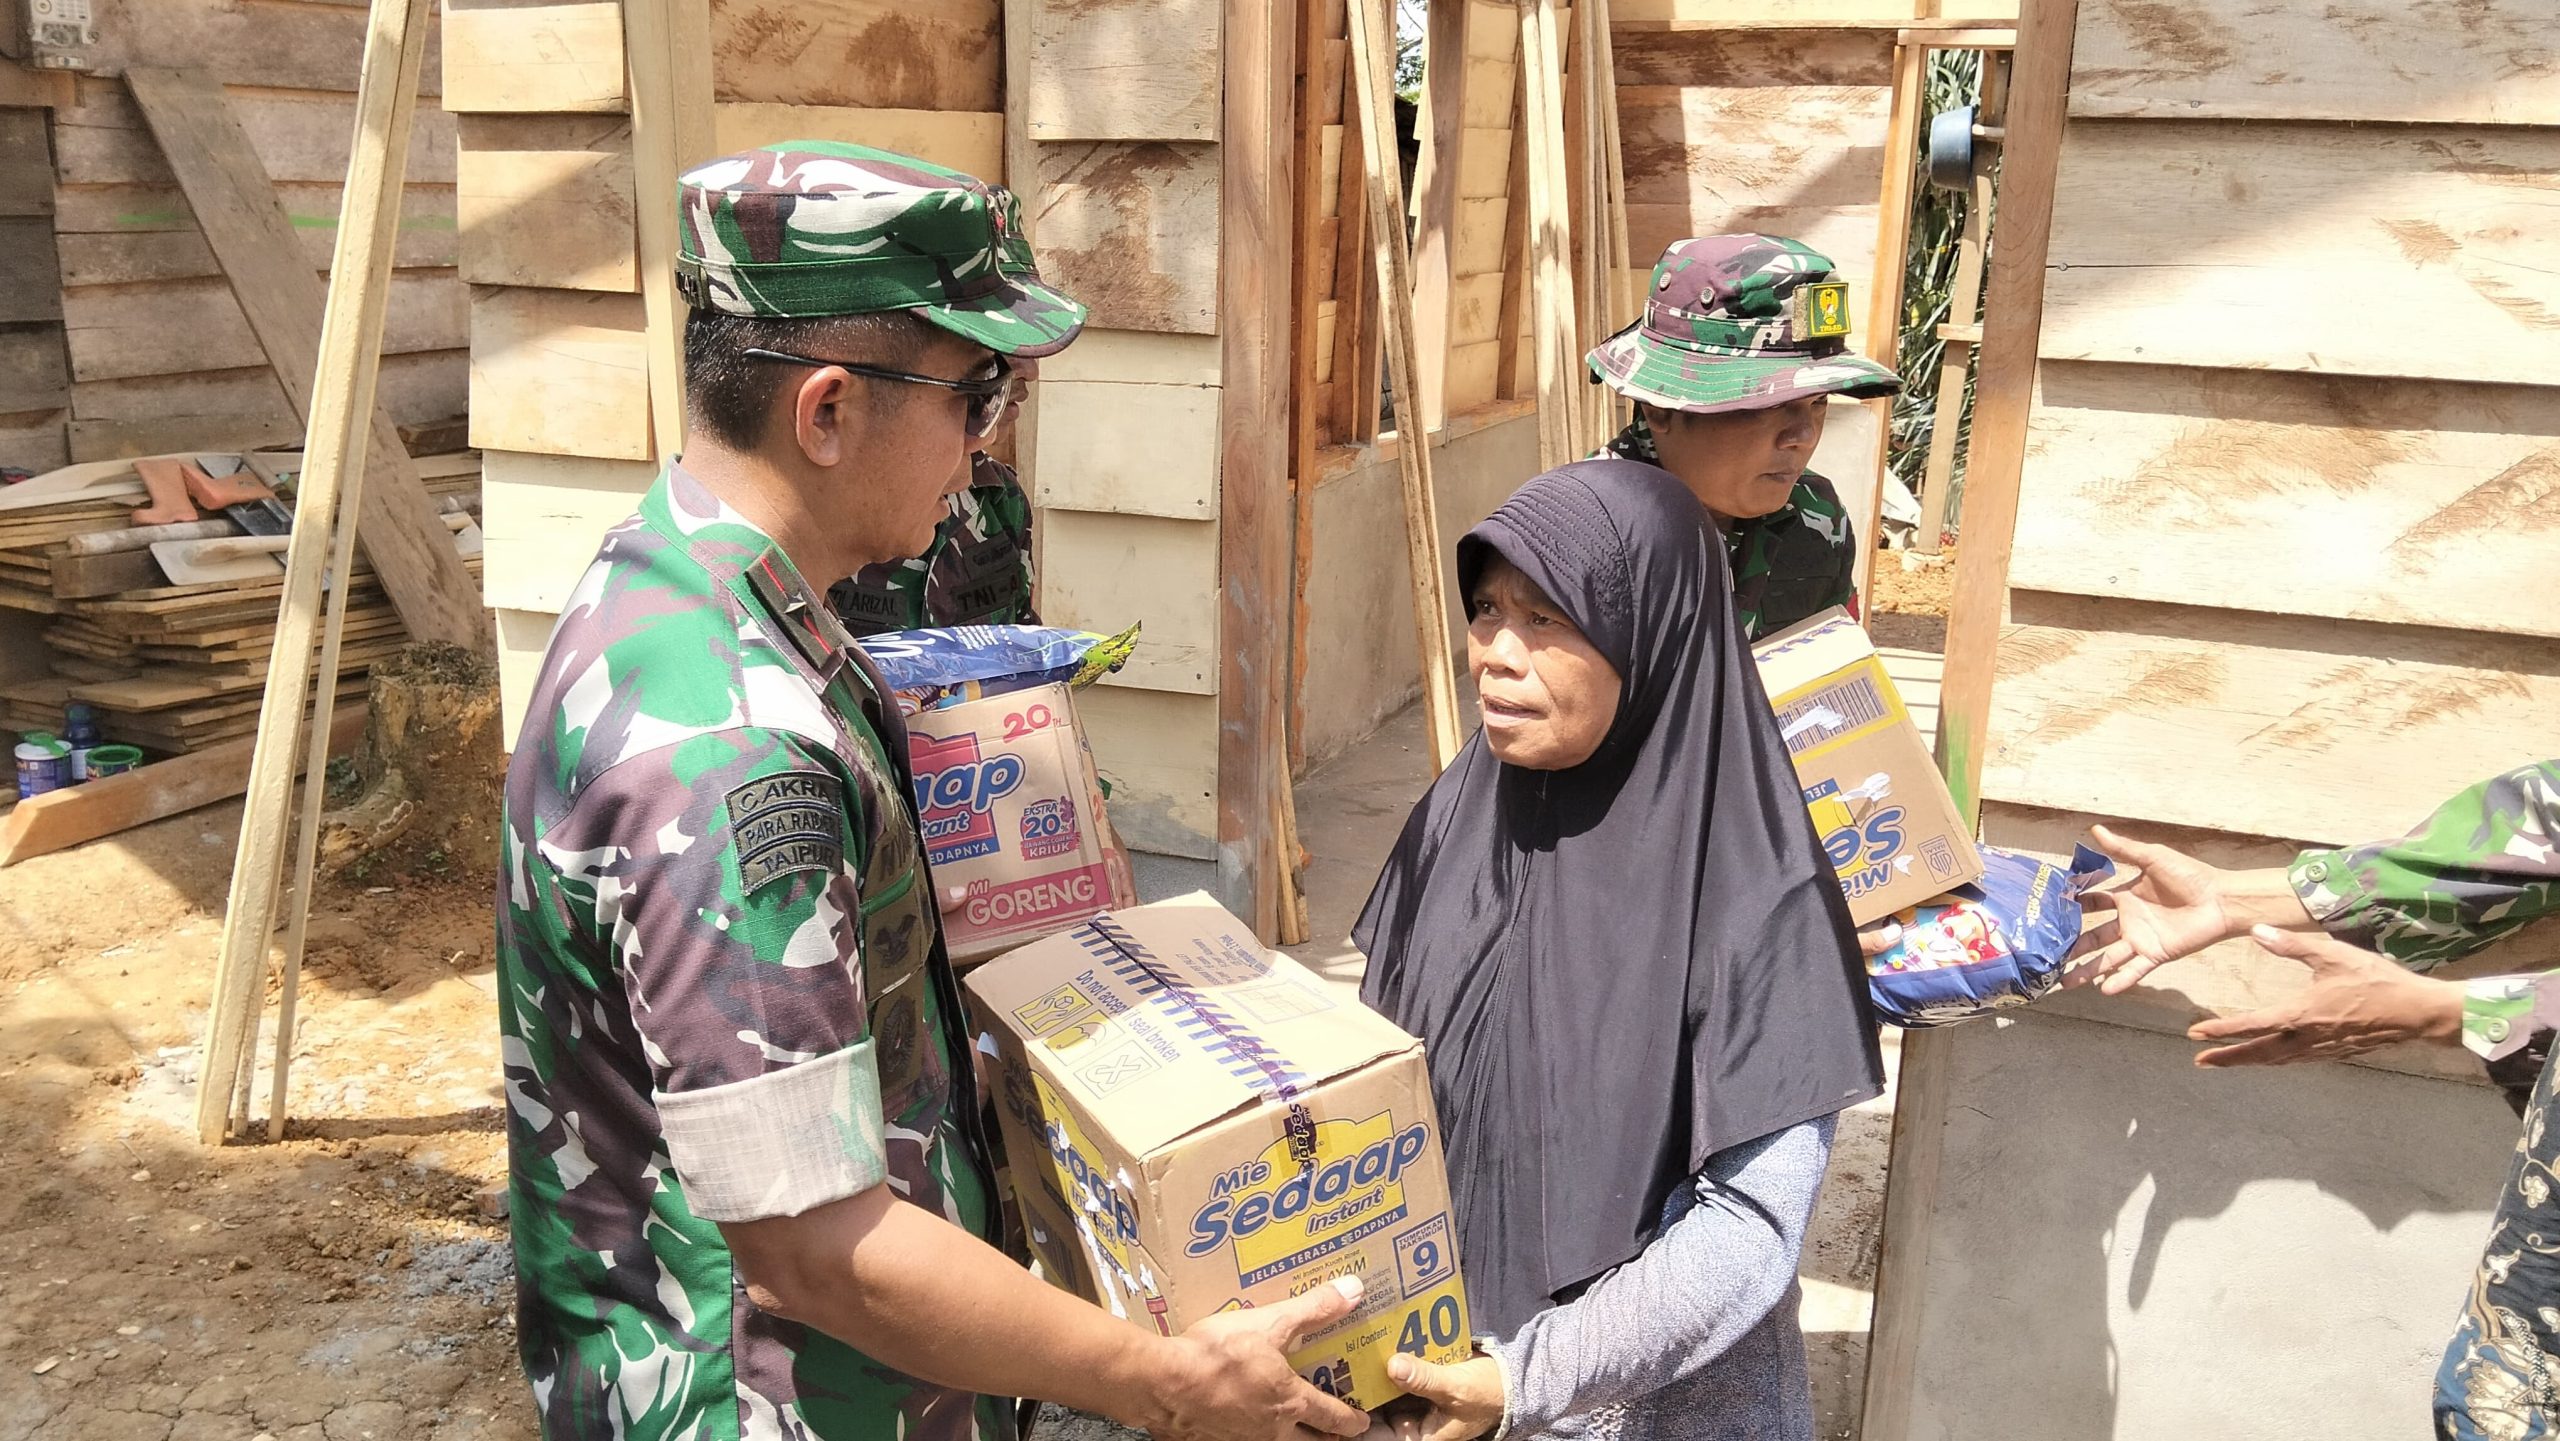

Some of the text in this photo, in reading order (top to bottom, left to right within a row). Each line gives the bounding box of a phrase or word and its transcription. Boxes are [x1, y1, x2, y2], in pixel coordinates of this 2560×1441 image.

[738, 779, 831, 814] CAKRA
[745, 815, 786, 849] PARA
[755, 844, 836, 874] TAIPUR
[1029, 843, 1071, 858] KRIUK
[966, 875, 1095, 926] GORENG
[967, 879, 990, 898] MI
[1075, 969, 1094, 985] Do
[1086, 981, 1110, 997] not
[1097, 991, 1135, 1016] accept
[1129, 1017, 1158, 1037] seal
[1145, 1030, 1181, 1063] broken
[1186, 1123, 1428, 1256] Sedaap
[1210, 1162, 1271, 1200] Mie
[1306, 1186, 1384, 1236] Instant
[1398, 1218, 1444, 1244] TUMPUKAN
[1400, 1225, 1444, 1250] MAKSIMUM
[1250, 1210, 1400, 1283] JELAS TERASA SEDAPNYA
[1412, 1240, 1439, 1278] 9
[1327, 1256, 1367, 1281] AYAM
[1369, 1286, 1395, 1304] SEGAR
[1346, 1340, 1356, 1353] Isi
[1360, 1326, 1388, 1346] Content
[1396, 1295, 1461, 1359] 40
